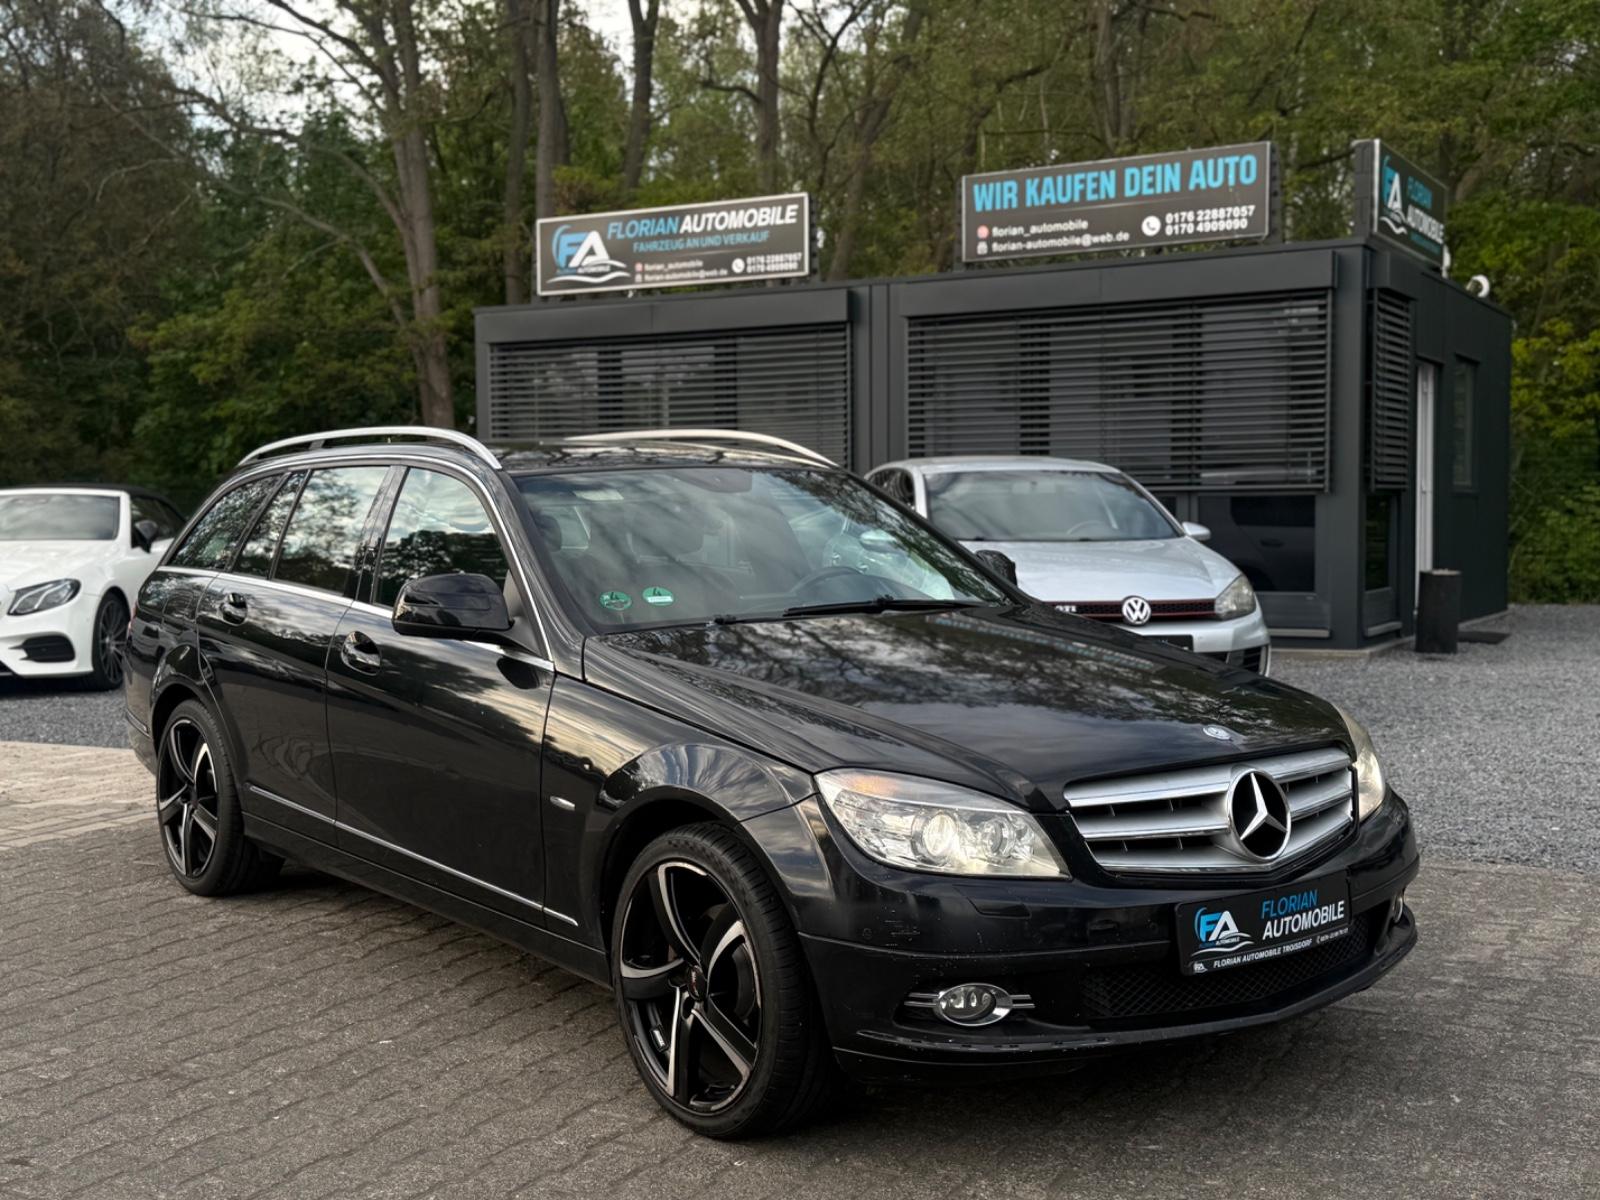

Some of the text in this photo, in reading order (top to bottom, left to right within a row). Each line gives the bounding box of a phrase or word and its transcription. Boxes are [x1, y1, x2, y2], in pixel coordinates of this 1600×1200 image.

[973, 154, 1258, 212] WIR KAUFEN DEIN AUTO
[607, 204, 799, 240] FLORIAN AUTOMOBILE
[992, 219, 1089, 237] florian_automobile
[1164, 211, 1195, 224] 0176
[1164, 223, 1195, 236] 0170
[633, 230, 770, 253] FAHRZEUG AN UND VERKAUF
[992, 231, 1130, 252] florian-automobile@web.de
[1261, 889, 1318, 919] FLORIAN
[1262, 900, 1345, 940] AUTOMOBILE
[1213, 938, 1313, 969] FLORIAN AUTOMOBILE TROISDORF
